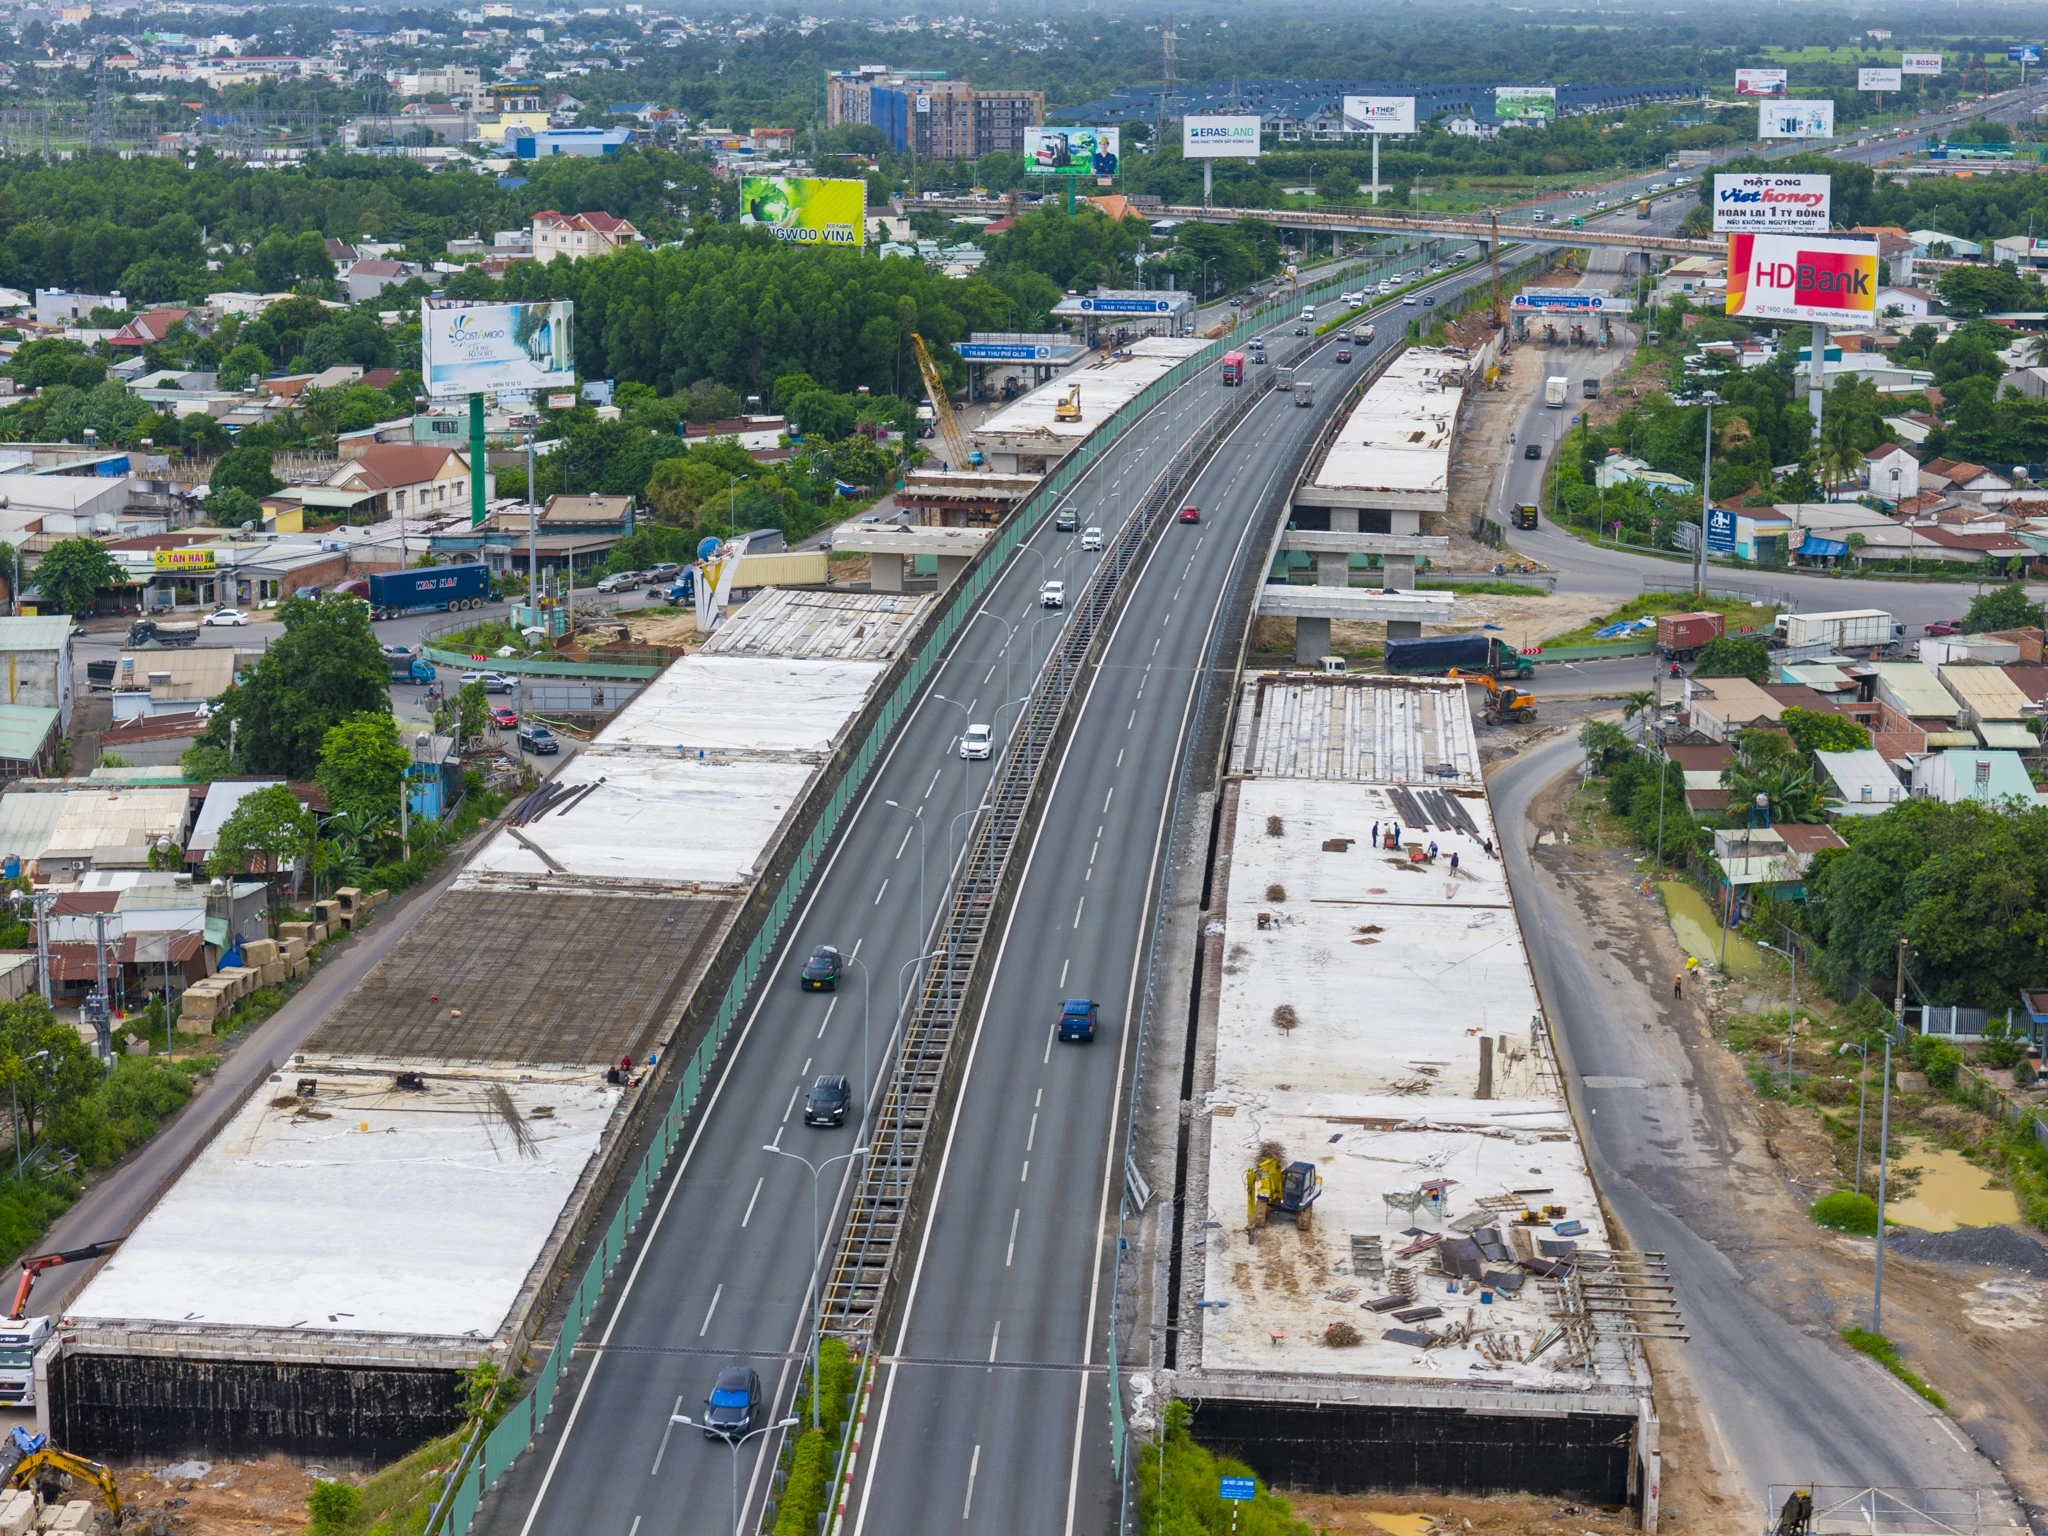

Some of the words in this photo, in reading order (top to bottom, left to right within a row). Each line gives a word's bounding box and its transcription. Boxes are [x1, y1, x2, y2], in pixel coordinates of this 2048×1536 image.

[1200, 128, 1254, 137] ERASLAND
[1743, 177, 1772, 188] MẬT
[1774, 179, 1802, 187] ONG
[1750, 209, 1766, 219] LẠI
[1769, 206, 1777, 217] 1
[821, 229, 855, 242] VINA
[1755, 262, 1870, 295] HDBank
[1782, 307, 1798, 315] 6060
[167, 552, 186, 563] TÂN
[188, 551, 204, 563] HẢI
[415, 579, 437, 591] WAN
[439, 577, 458, 589] HAI
[63, 1462, 88, 1480] HYUNDAI
